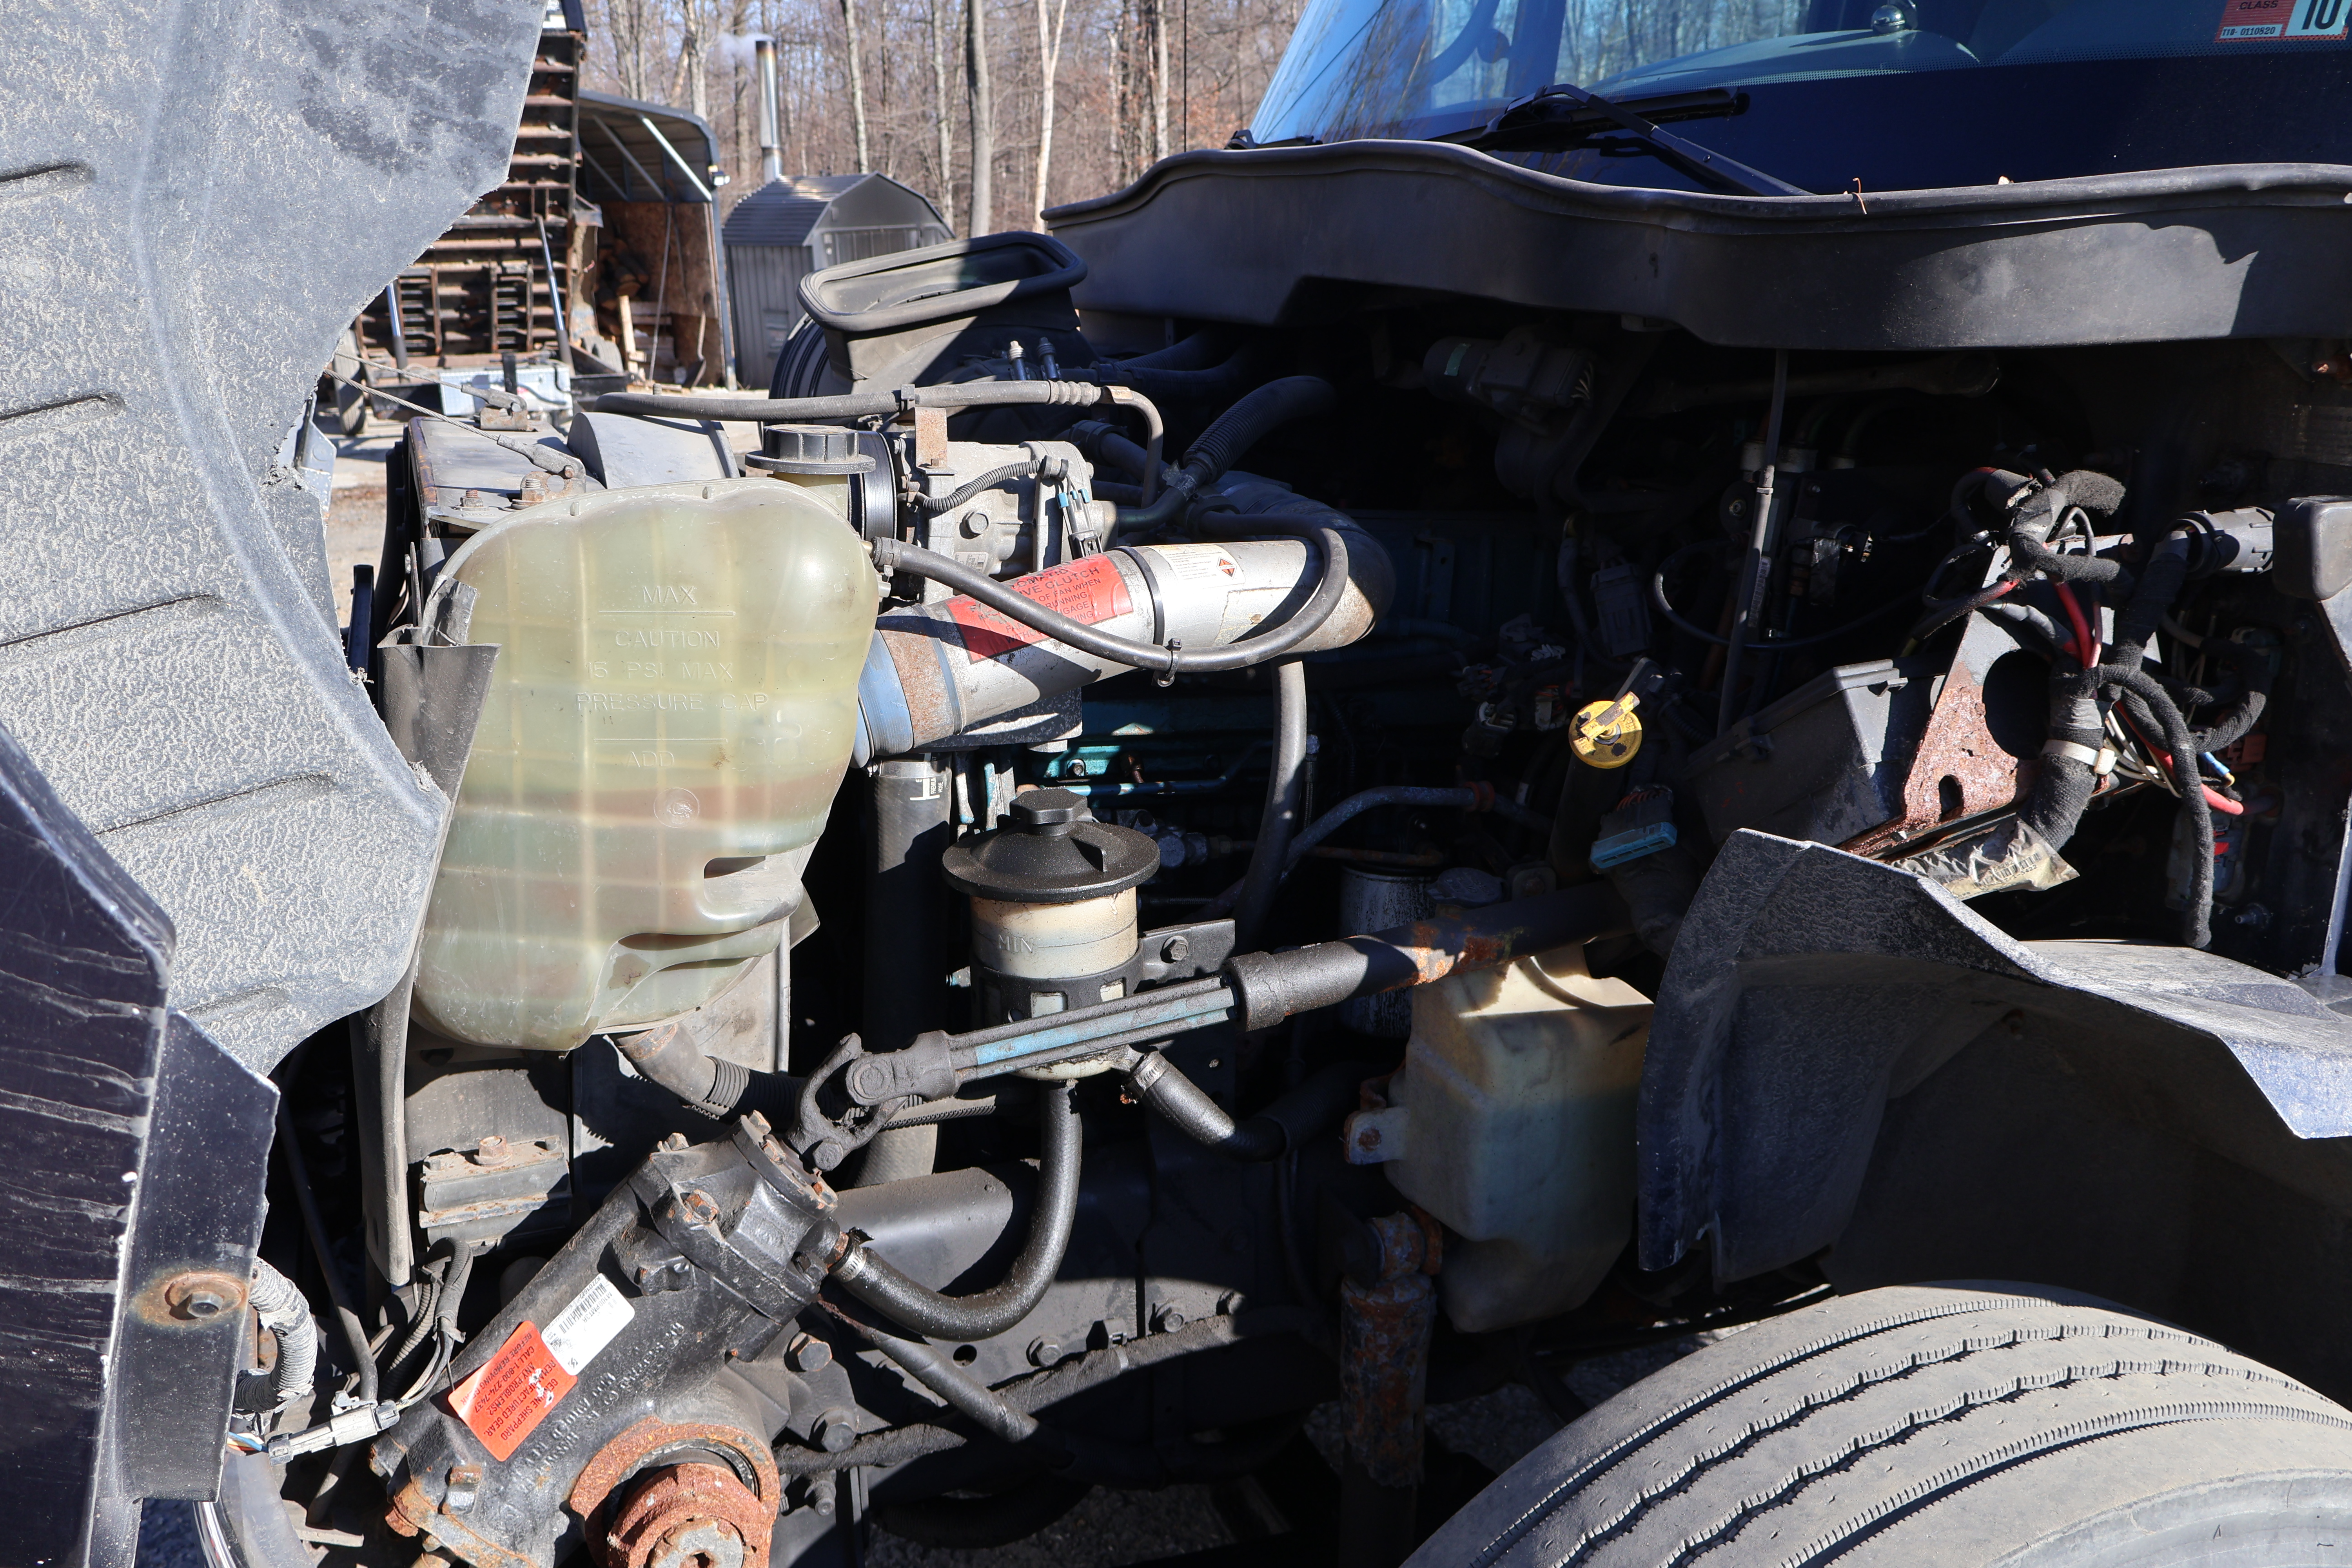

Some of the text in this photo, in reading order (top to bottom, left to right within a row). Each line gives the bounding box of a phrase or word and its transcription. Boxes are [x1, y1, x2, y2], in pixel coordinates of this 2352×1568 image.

[2239, 0, 2278, 9] CLASS
[2240, 27, 2276, 36] 0110820
[1045, 566, 1099, 590] CLUTCH
[642, 585, 697, 604] MAX
[1038, 593, 1051, 603] OF
[1054, 587, 1071, 597] FAN
[1073, 578, 1101, 591] WHEN
[615, 630, 720, 648] CAUTION
[588, 661, 733, 679] 15 PSI MAX
[576, 693, 769, 711] PRESSURE CAP
[627, 751, 675, 768] ADD
[998, 934, 1034, 953] MIN
[506, 1332, 533, 1360] BEFORE
[472, 1345, 535, 1413] CALL 1-800-274-7437
[478, 1356, 510, 1390] REMOVING
[486, 1361, 537, 1416] ANY PROBLEMS?
[483, 1416, 504, 1439] GEAR.
[499, 1405, 534, 1441] SHEPPARD
